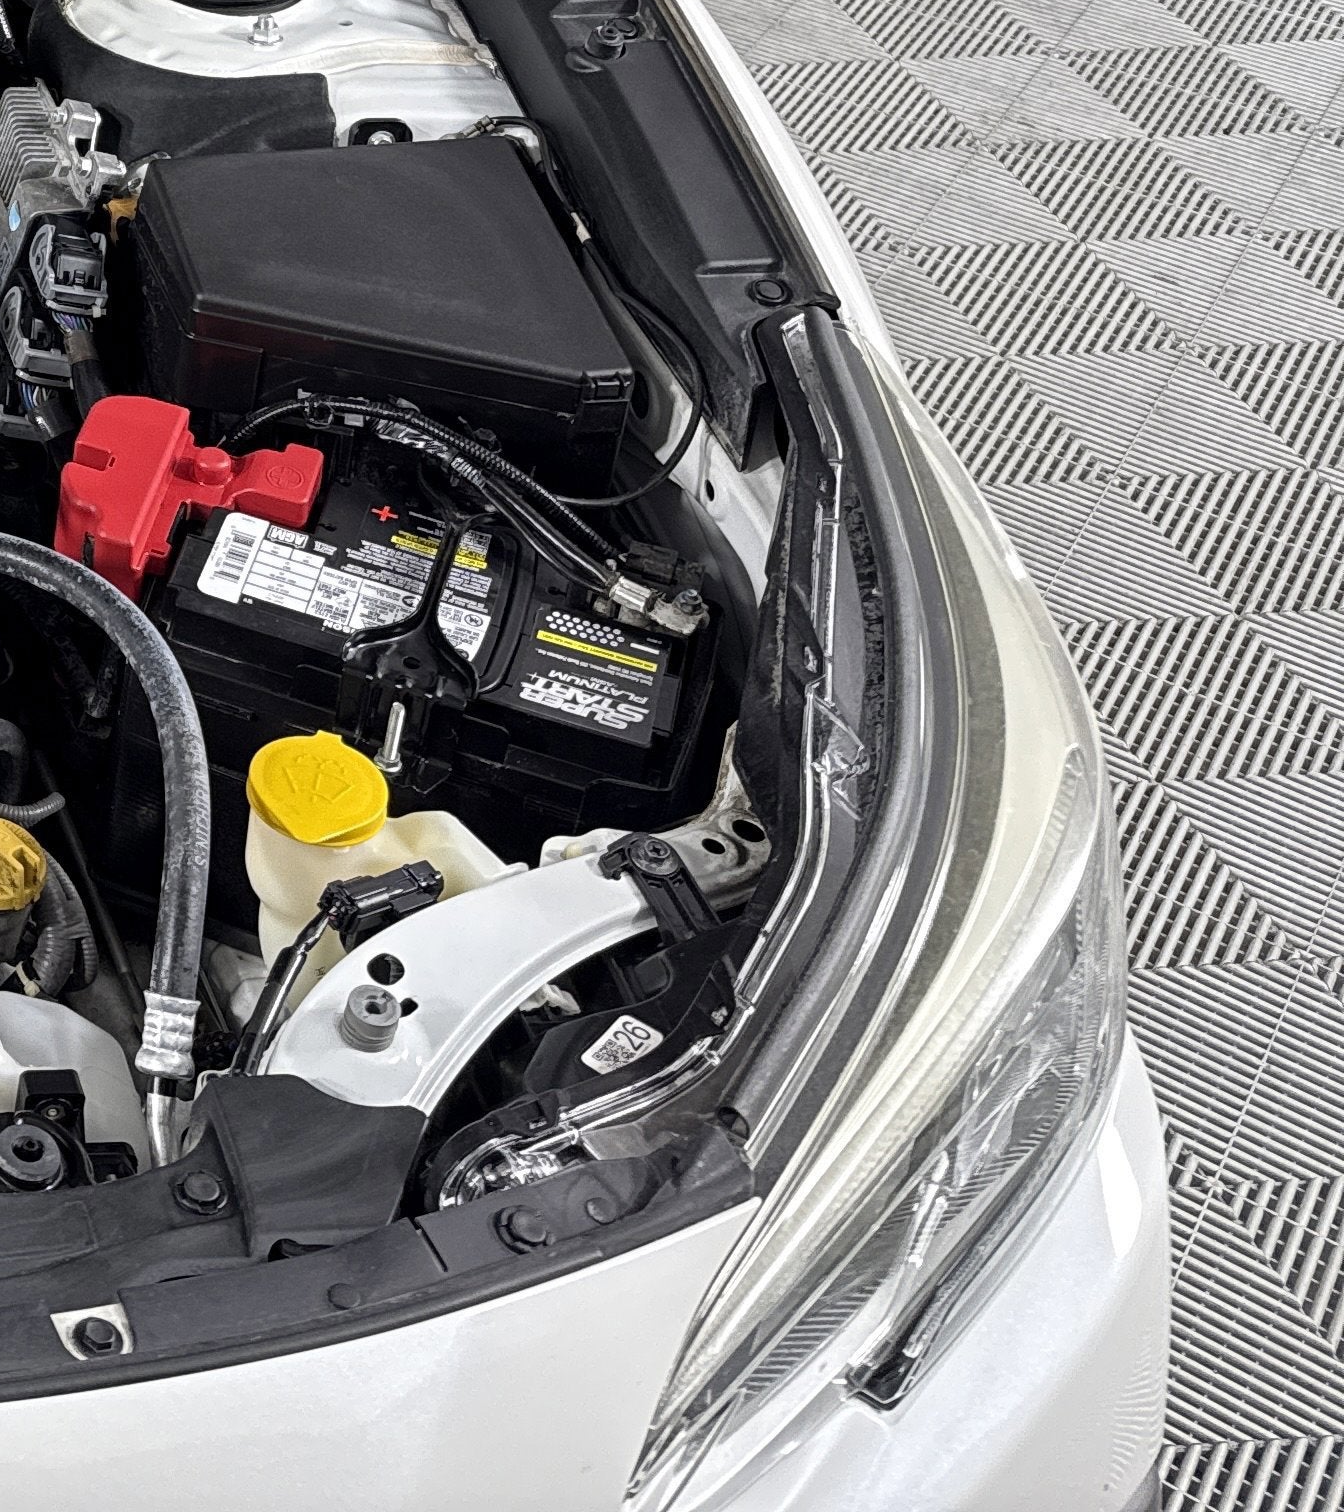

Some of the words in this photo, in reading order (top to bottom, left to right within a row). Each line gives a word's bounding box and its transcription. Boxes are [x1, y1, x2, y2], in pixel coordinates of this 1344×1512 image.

[268, 526, 306, 546] AGM
[521, 676, 650, 723] START
[548, 669, 649, 705] PLATINUM
[519, 687, 629, 730] SUPER
[613, 1021, 651, 1051] 26
